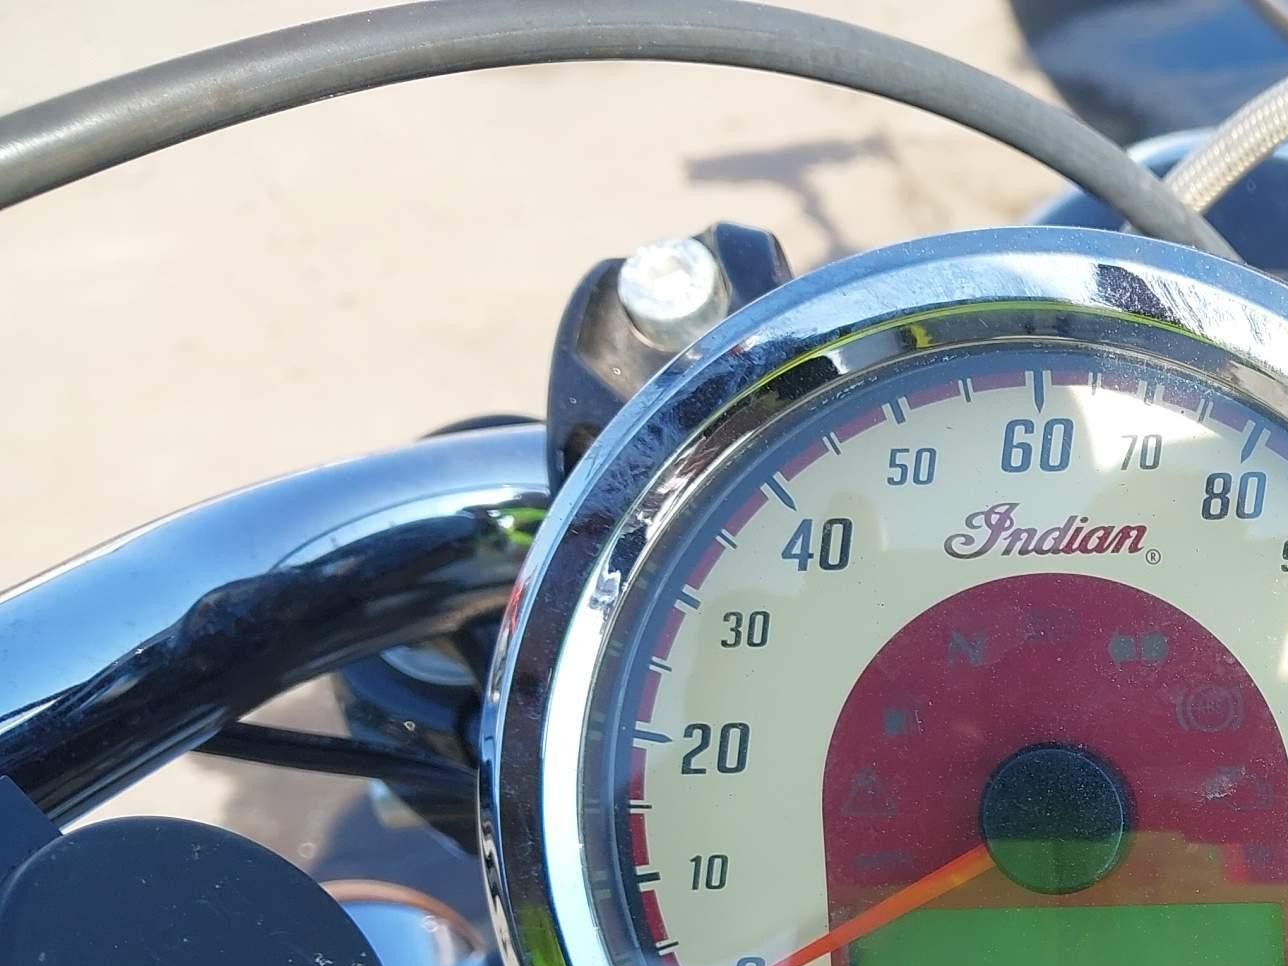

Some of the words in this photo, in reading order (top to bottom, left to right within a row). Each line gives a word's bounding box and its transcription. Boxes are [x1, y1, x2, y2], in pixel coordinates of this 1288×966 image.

[887, 448, 937, 486] 50
[1000, 418, 1074, 473] 60
[1120, 434, 1163, 470] 70
[1201, 471, 1268, 520] 80
[781, 518, 853, 571] 40
[943, 502, 1149, 560] Indian
[721, 611, 770, 648] 30
[681, 722, 750, 774] 20
[690, 854, 728, 890] 10
